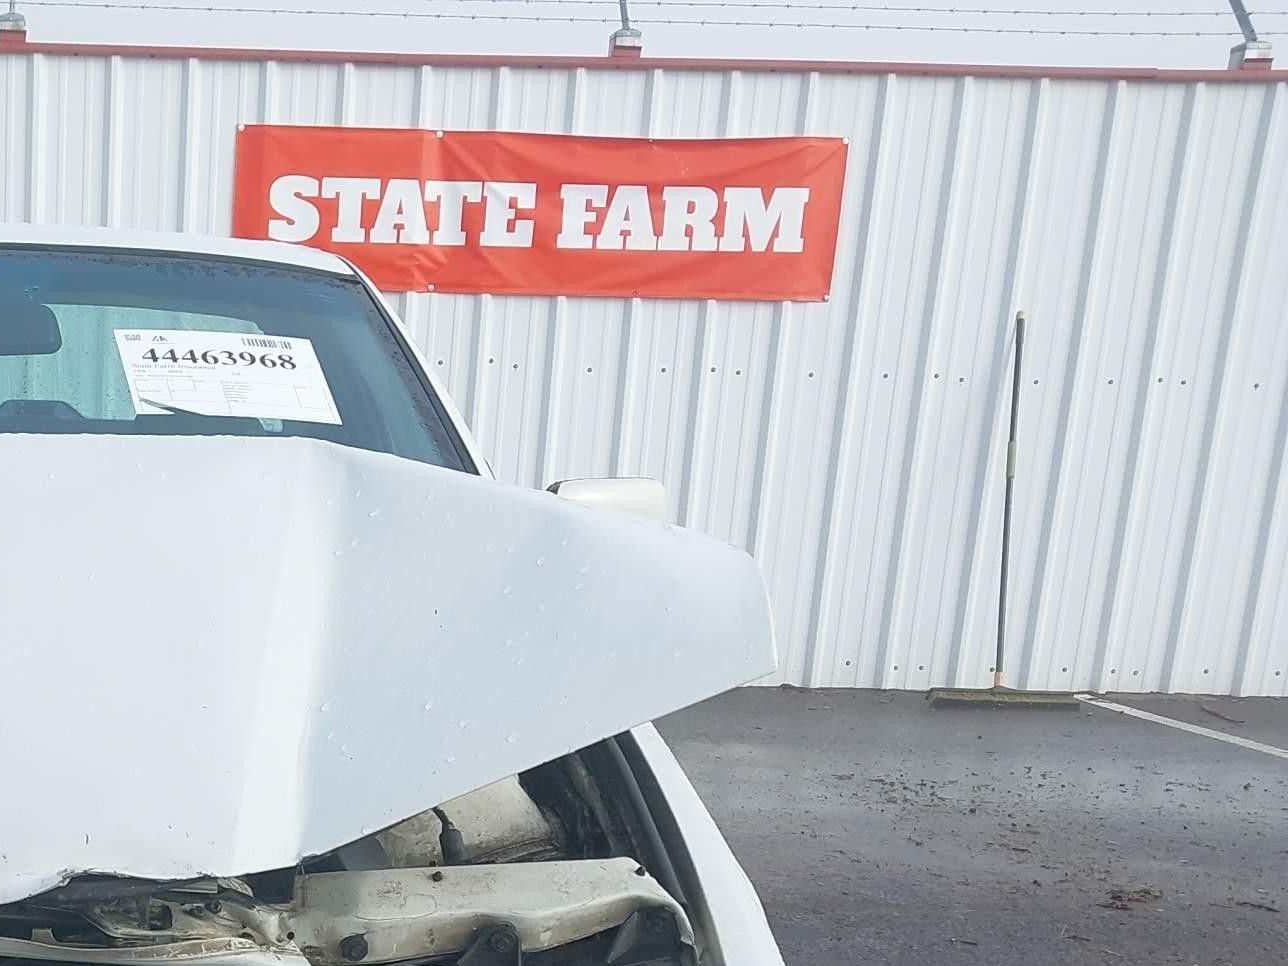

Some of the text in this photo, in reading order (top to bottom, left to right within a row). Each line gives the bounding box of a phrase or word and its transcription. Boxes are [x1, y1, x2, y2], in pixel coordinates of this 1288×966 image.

[268, 174, 811, 253] STATE FARM
[142, 348, 297, 370] 44463968
